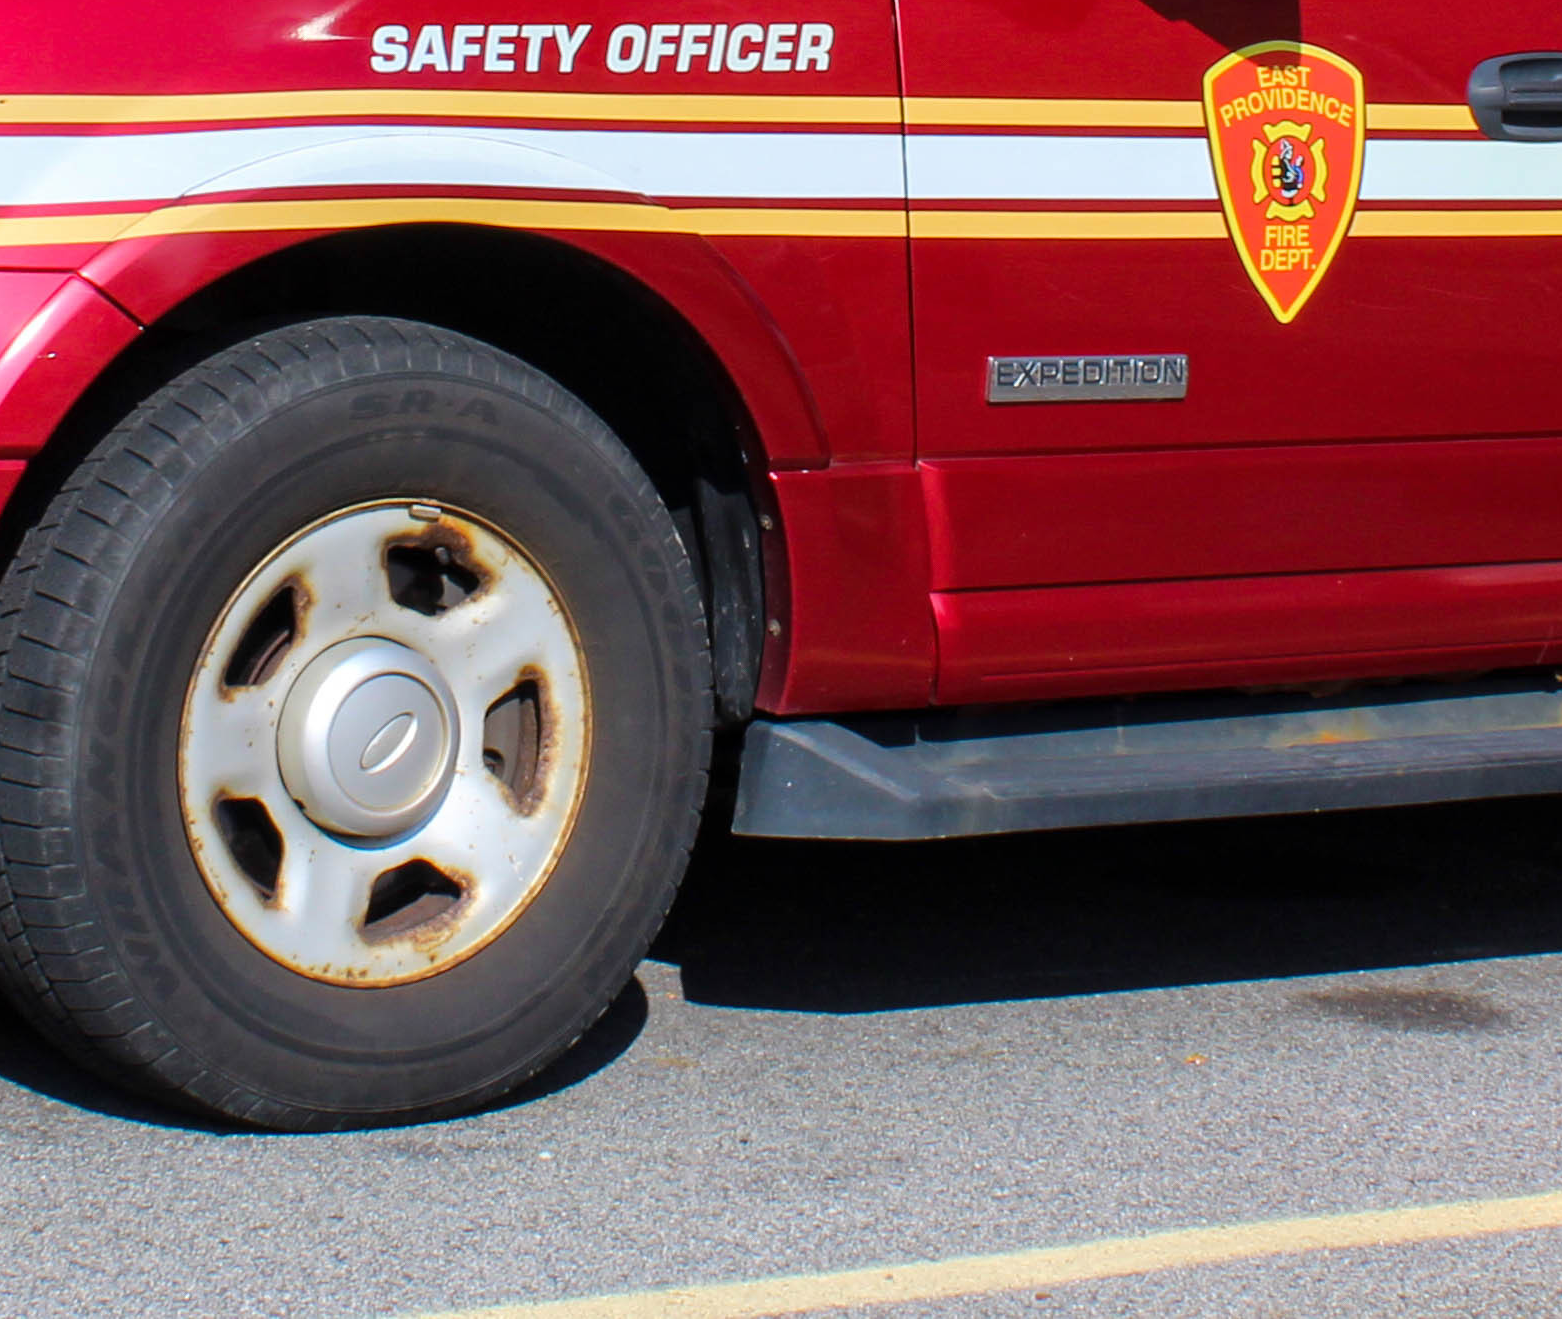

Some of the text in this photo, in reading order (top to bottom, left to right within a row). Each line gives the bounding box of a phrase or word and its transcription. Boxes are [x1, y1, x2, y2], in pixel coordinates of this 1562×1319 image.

[370, 23, 835, 73] SAFETY OFFICER
[1256, 66, 1312, 88] EAST
[1219, 88, 1354, 127] PROVIDENCE
[1265, 225, 1310, 247] FIRE
[1260, 249, 1317, 271] DEPT.
[993, 358, 1187, 387] EXPEDITION
